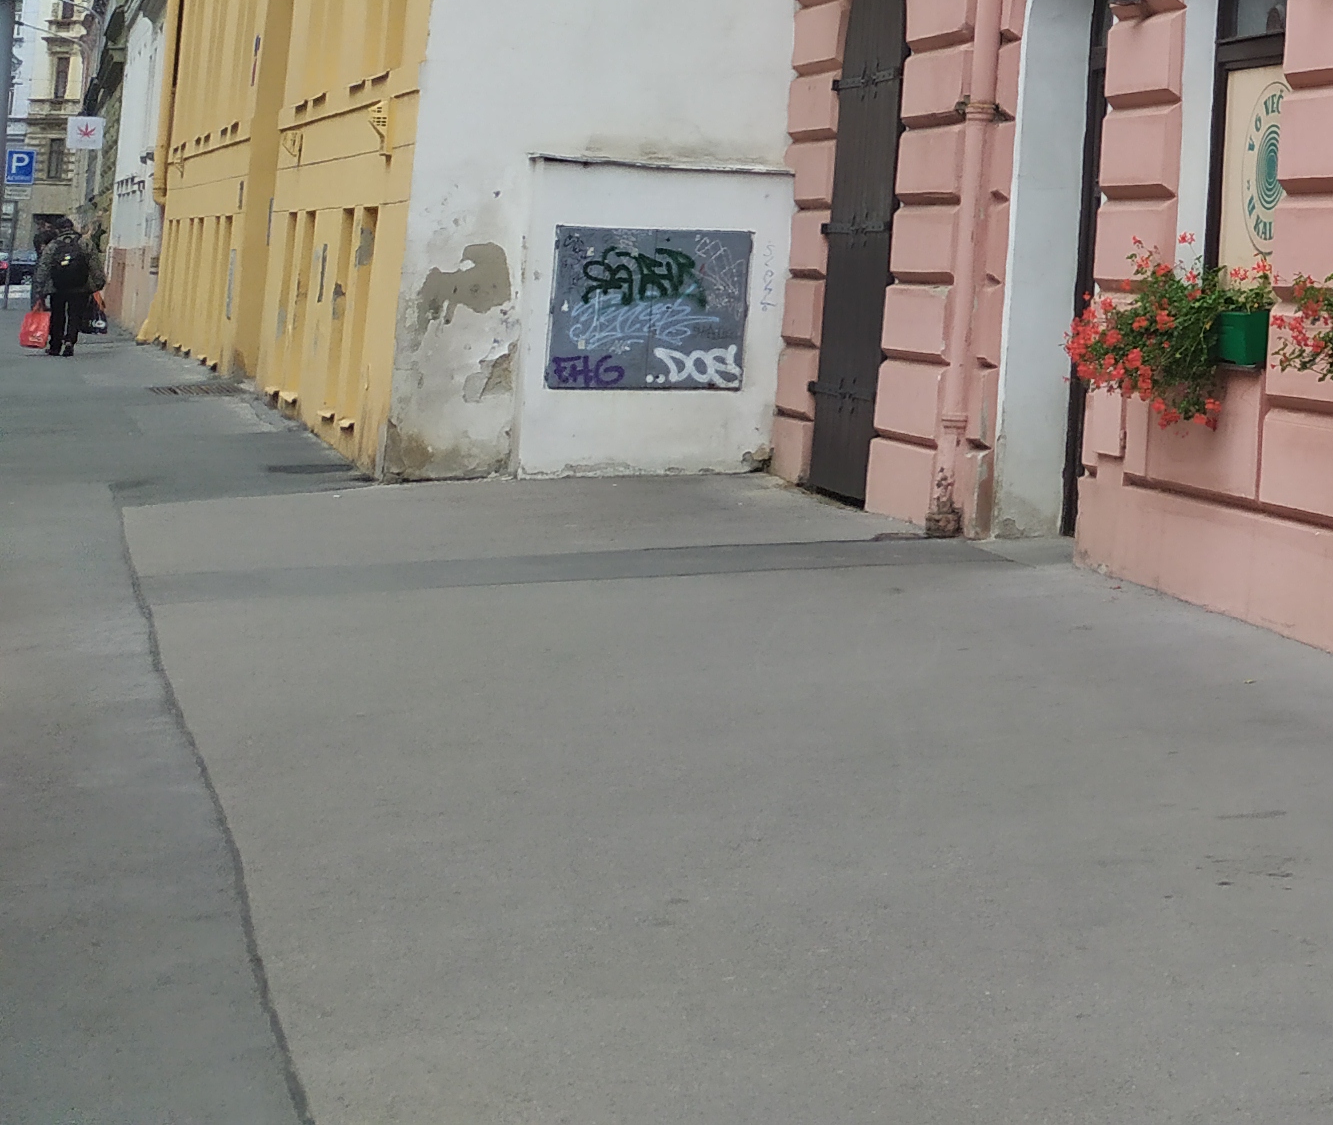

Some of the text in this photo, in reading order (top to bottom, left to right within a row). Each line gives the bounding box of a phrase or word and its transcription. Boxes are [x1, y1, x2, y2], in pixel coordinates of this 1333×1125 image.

[1255, 113, 1262, 133] 6
[1264, 89, 1284, 116] VEČ
[11, 153, 30, 174] P
[1253, 214, 1274, 241] KAL
